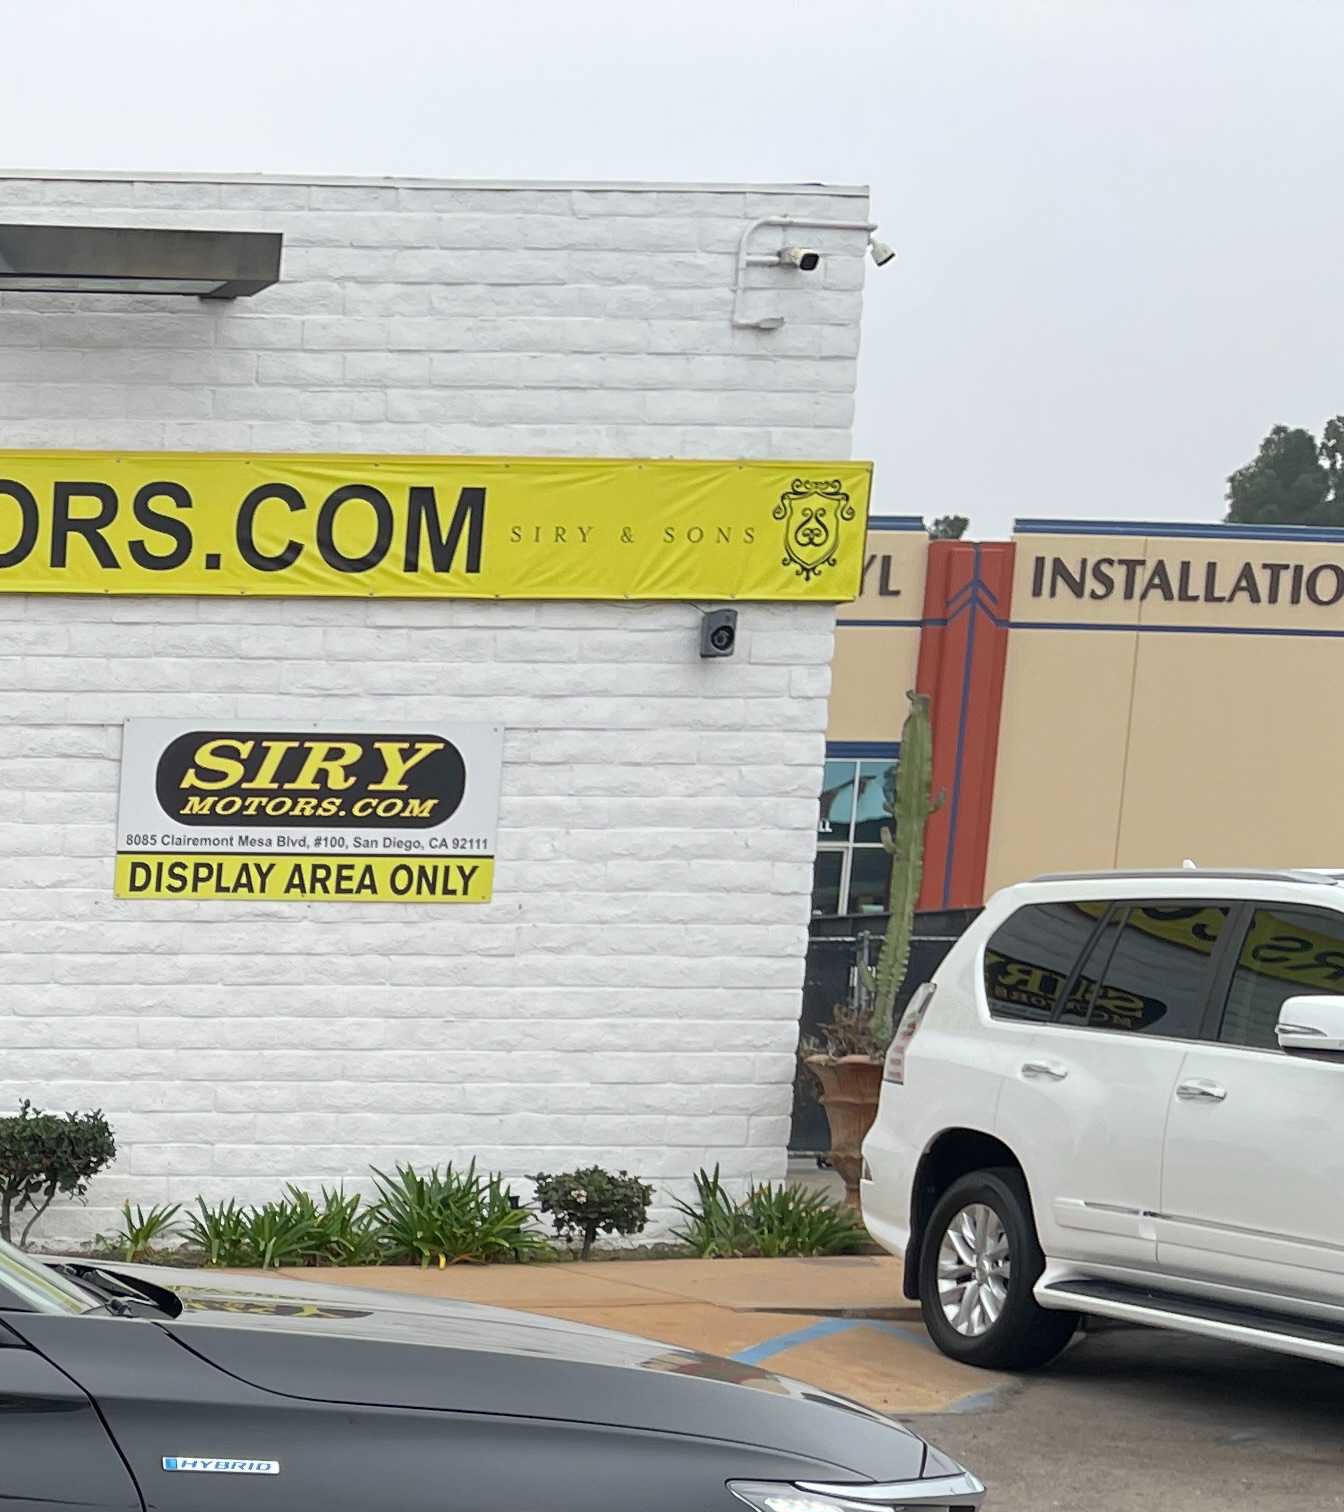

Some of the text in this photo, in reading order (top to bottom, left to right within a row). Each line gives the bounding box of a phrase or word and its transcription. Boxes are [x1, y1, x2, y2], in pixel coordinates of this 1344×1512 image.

[509, 524, 758, 545] SIRY & SONS
[1032, 556, 1344, 606] INSTALLATIO
[179, 738, 445, 791] SIRY
[179, 795, 439, 817] MOTORS.COM
[126, 833, 488, 851] 8085 Clairemont Mesa Blvd, #100, San Diego, CA 92111
[128, 860, 480, 896] DISPLAY AREA ONLY
[181, 1459, 273, 1472] HYBRID
